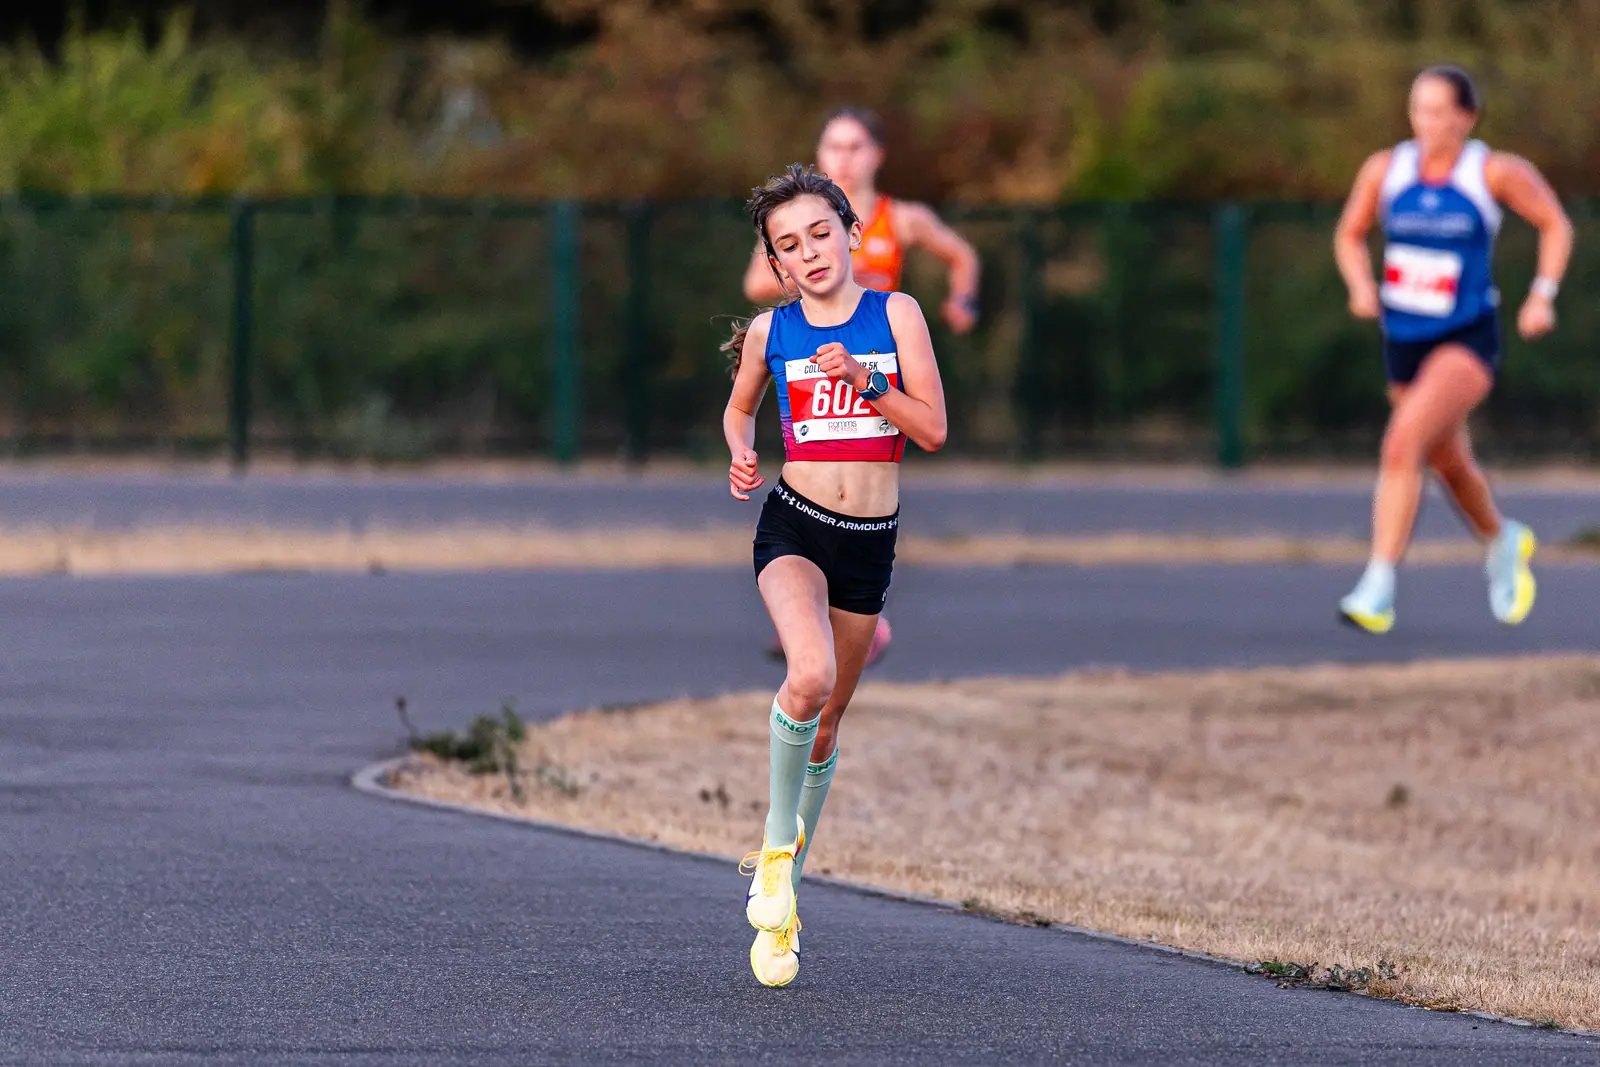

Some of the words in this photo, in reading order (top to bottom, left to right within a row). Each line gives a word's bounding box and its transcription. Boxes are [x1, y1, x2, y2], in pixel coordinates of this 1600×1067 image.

[868, 361, 878, 370] 5K
[812, 380, 870, 416] 602
[796, 501, 835, 526] UNDER
[836, 520, 887, 531] ARMOUR
